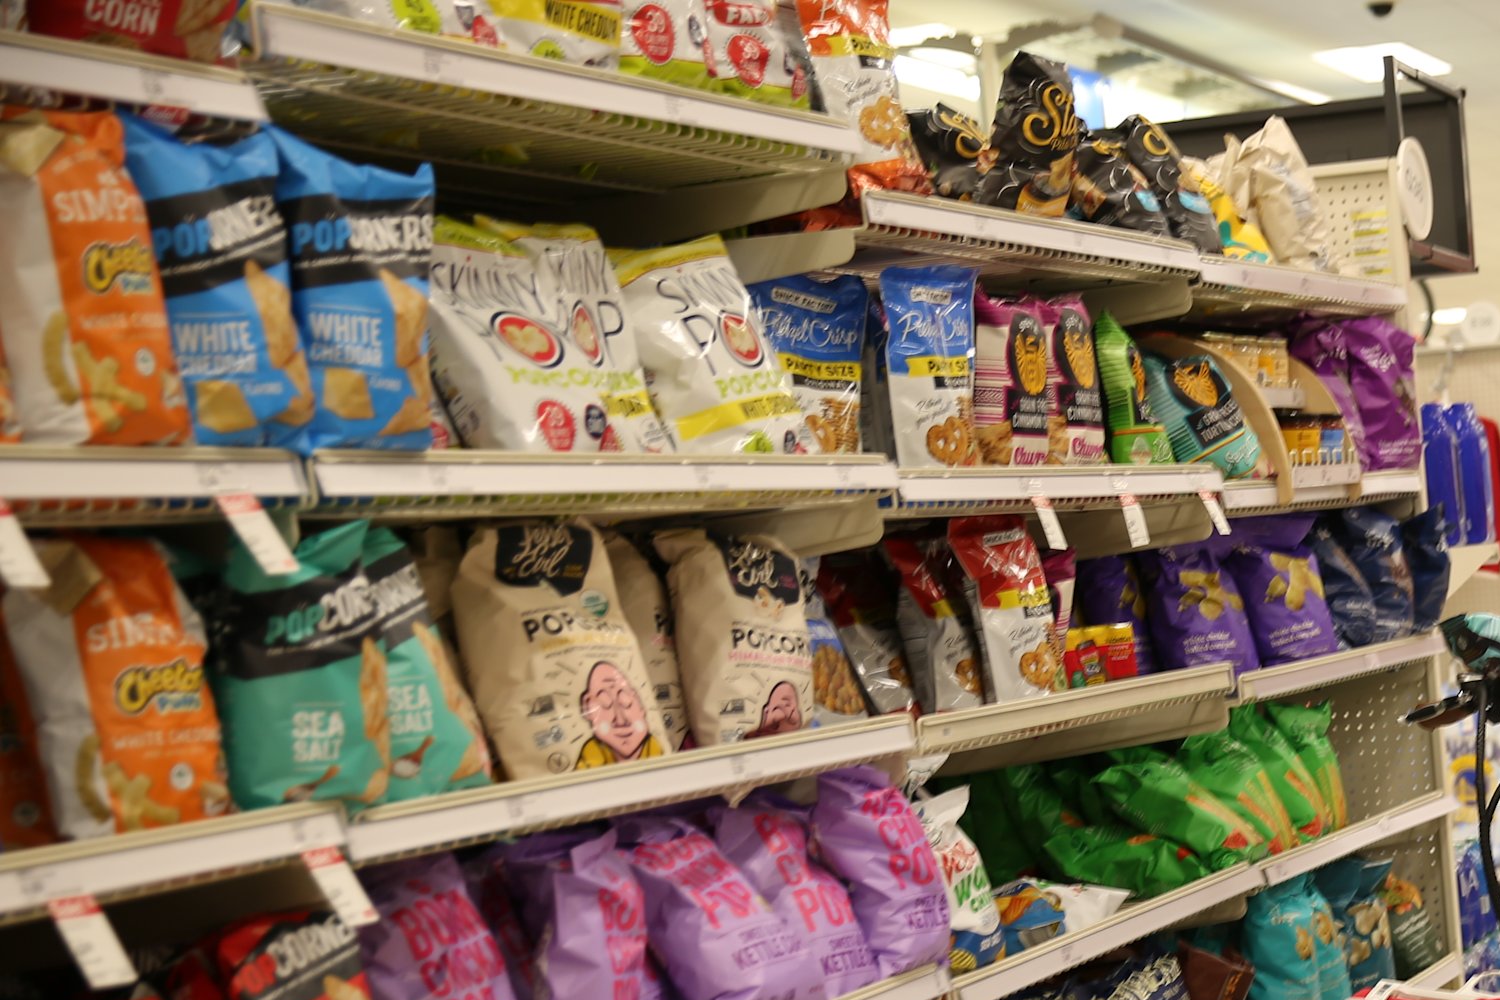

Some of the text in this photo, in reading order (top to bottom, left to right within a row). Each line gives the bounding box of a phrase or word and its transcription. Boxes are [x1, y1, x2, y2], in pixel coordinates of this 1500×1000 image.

[174, 320, 255, 353] WHITE
[309, 312, 382, 347] WHITE
[825, 362, 857, 378] SIZE
[388, 682, 432, 711] SEA
[291, 710, 345, 739] SEA
[389, 709, 433, 735] SALT
[292, 735, 343, 763] SALT
